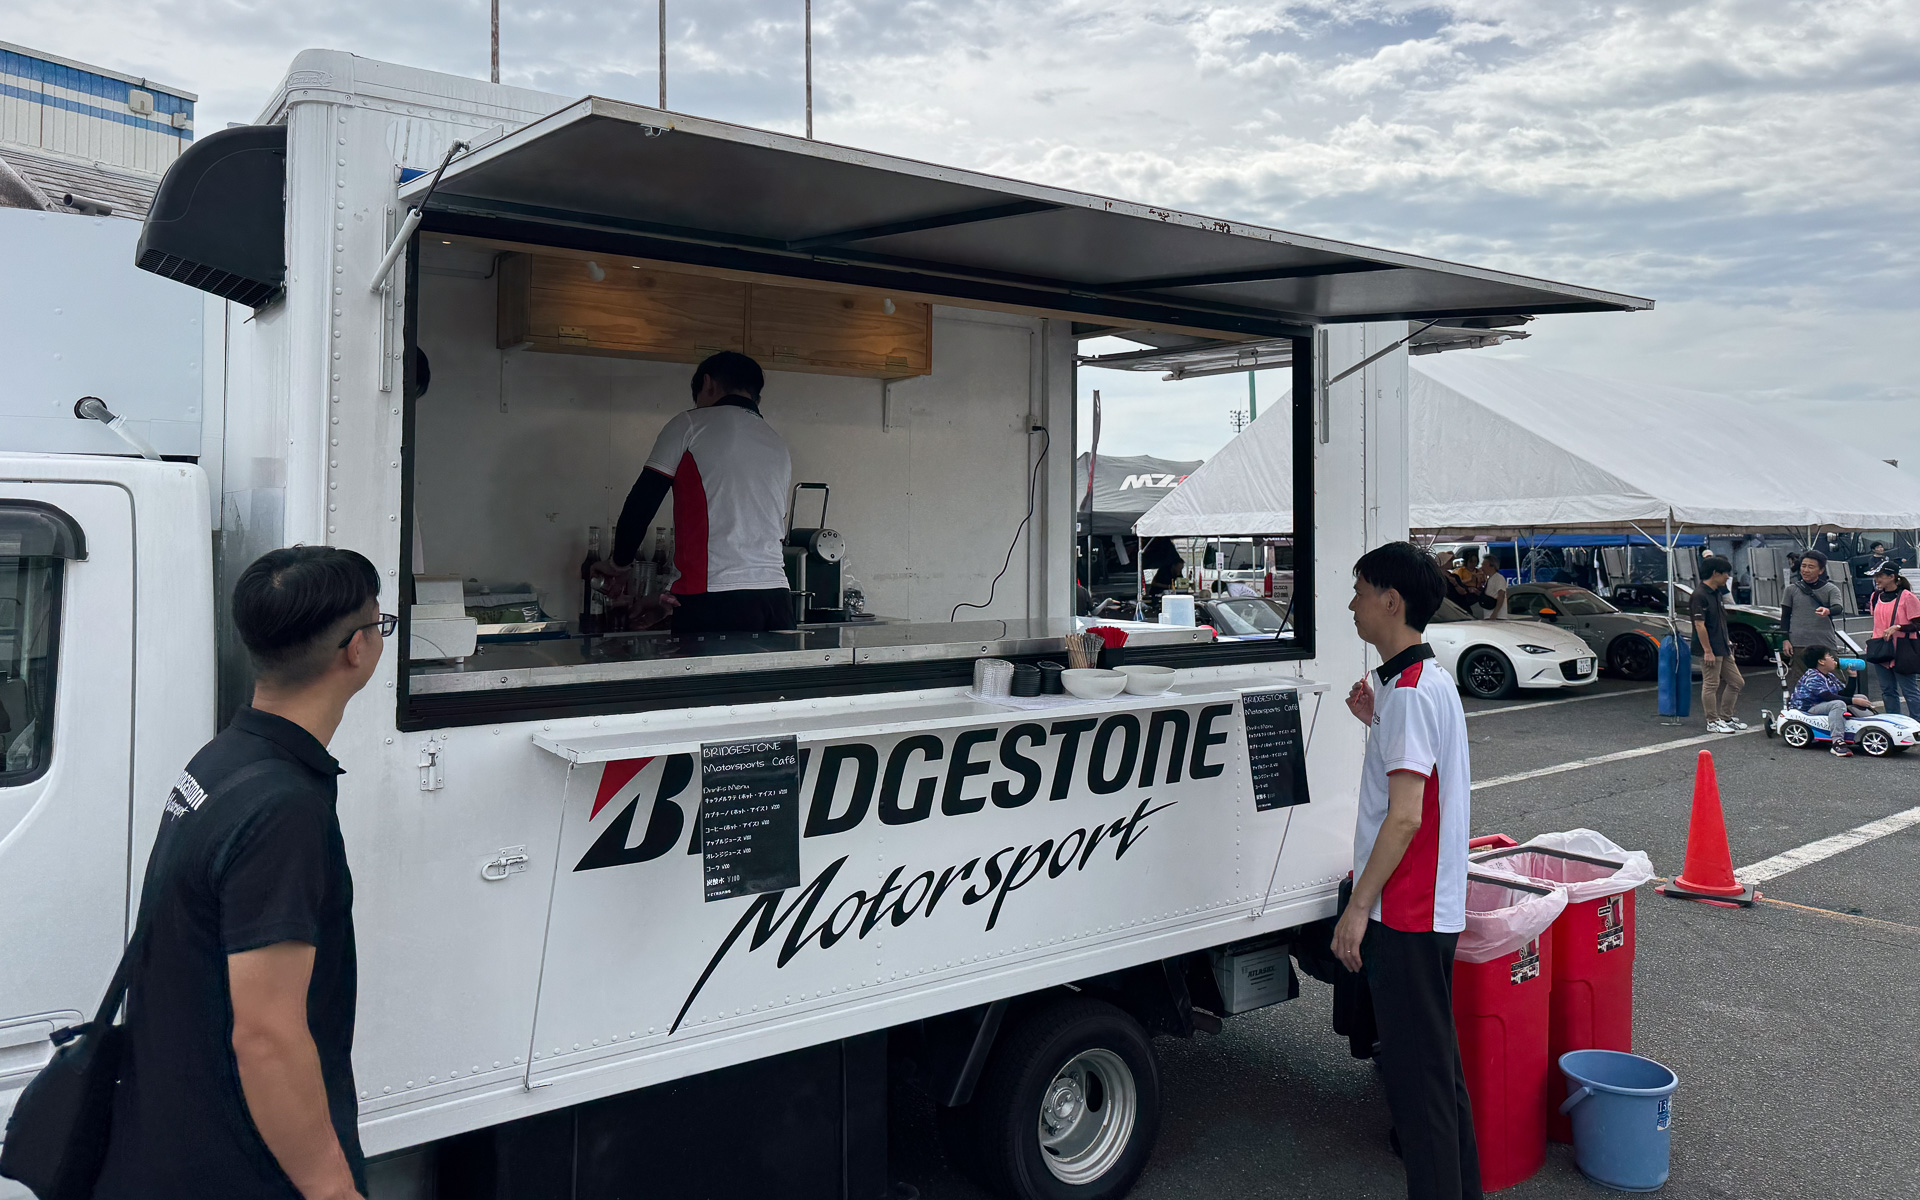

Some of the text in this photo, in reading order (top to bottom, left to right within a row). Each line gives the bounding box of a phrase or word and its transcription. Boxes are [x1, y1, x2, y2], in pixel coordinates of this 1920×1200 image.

[1243, 693, 1289, 704] BRIDGESTONE
[1284, 703, 1298, 711] Café
[703, 741, 781, 758] BRIDGESTONE
[703, 755, 796, 774] Motorsports Café
[572, 703, 1233, 872] BDGESTONE
[728, 783, 750, 791] Menu
[669, 799, 1178, 1036] Motorsport
